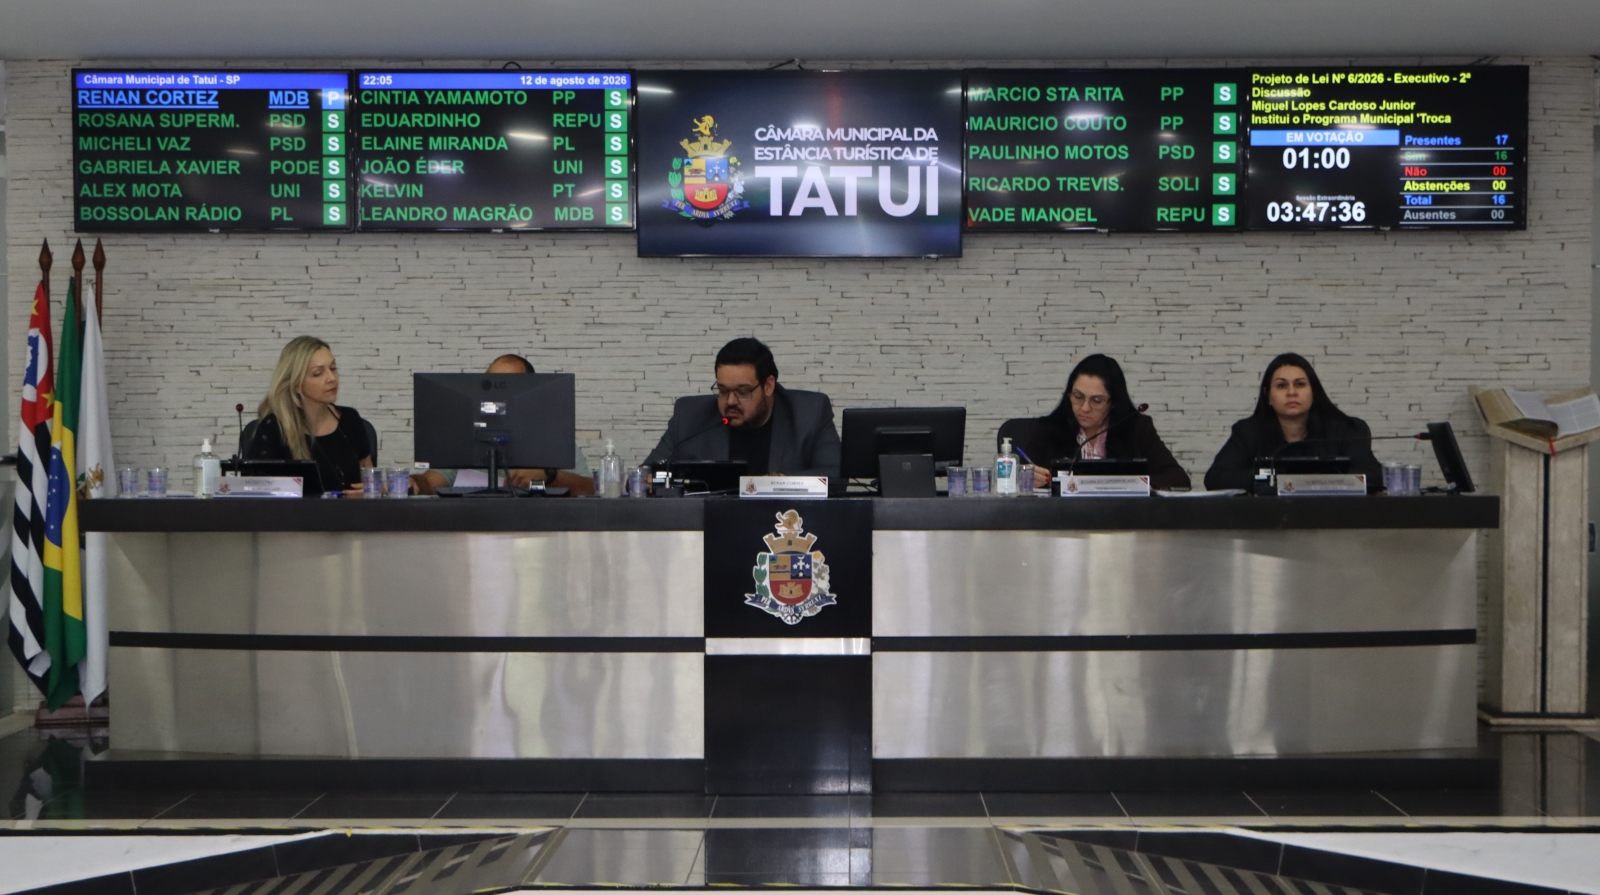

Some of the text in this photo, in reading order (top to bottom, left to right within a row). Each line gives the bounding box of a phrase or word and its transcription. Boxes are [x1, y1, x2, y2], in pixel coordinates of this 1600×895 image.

[84, 75, 123, 84] Câmara
[126, 75, 175, 86] Municipal
[177, 75, 190, 84] de
[226, 75, 240, 84] SP
[363, 76, 392, 85] 22:05
[520, 76, 627, 87] 12 de agosto de 2026
[1252, 74, 1293, 85] Projeto
[1295, 74, 1309, 84] de
[1312, 74, 1328, 84] Lei
[1348, 74, 1384, 84] 6/2026
[1394, 73, 1449, 84] Executivo
[78, 90, 339, 105] RENAN CORTEZ MDB P
[361, 90, 622, 106] CINTIA YAMAMOTO PP S
[969, 86, 1231, 101] MARCIO STA RITA PP S
[1252, 88, 1311, 98] Discussão
[1252, 100, 1415, 113] Miguel Lopes Cardoso Junior
[78, 113, 339, 128] ROSANA SUPERM. PSD S
[361, 113, 622, 129] EDUARDINHO REPU S
[969, 116, 1231, 131] MAURICIO COUTO PP S
[1251, 114, 1290, 124] Institui
[1293, 116, 1300, 124] o
[1303, 114, 1357, 126] Programa
[1360, 114, 1414, 125] Municipal
[755, 124, 938, 141] CÂMARA MUNICIPAL DA
[1286, 131, 1364, 144] EM VOTAÇÃO
[1404, 135, 1508, 145] Presentes 17
[79, 137, 340, 151] MICHELI VAZ PSD S
[361, 137, 622, 152] ELAINE MIRANDA PL S
[754, 144, 831, 161] ESTÂNCIA
[833, 144, 910, 161] TURÍSTICA
[969, 145, 1230, 160] PAULINHO MOTOS PSD S
[1283, 148, 1350, 169] 01:00
[1495, 151, 1507, 160] 16
[79, 160, 340, 175] GABRIELA XAVIER PODE S
[361, 157, 622, 174] JOÃO ÉDER UNI S
[1404, 166, 1506, 176] Não 00
[80, 183, 340, 198] ALEX MOTA UNI S
[361, 183, 623, 198] KELVIN PT S
[754, 159, 939, 216] TATUÍ
[969, 176, 1230, 191] RICARDO TREVIS. SOLI S
[1404, 181, 1506, 193] Abstenções 00
[1404, 195, 1505, 205] Total 16
[80, 203, 340, 221] BOSSOLAN RÁDIO PL S
[361, 204, 623, 221] LEANDRO MAGRÃO MDB S
[969, 207, 1230, 222] VADE MANOEL REPU S
[1267, 202, 1365, 222] 03:47:36
[1404, 210, 1504, 220] Ausentes 00
[494, 381, 507, 389] LG
